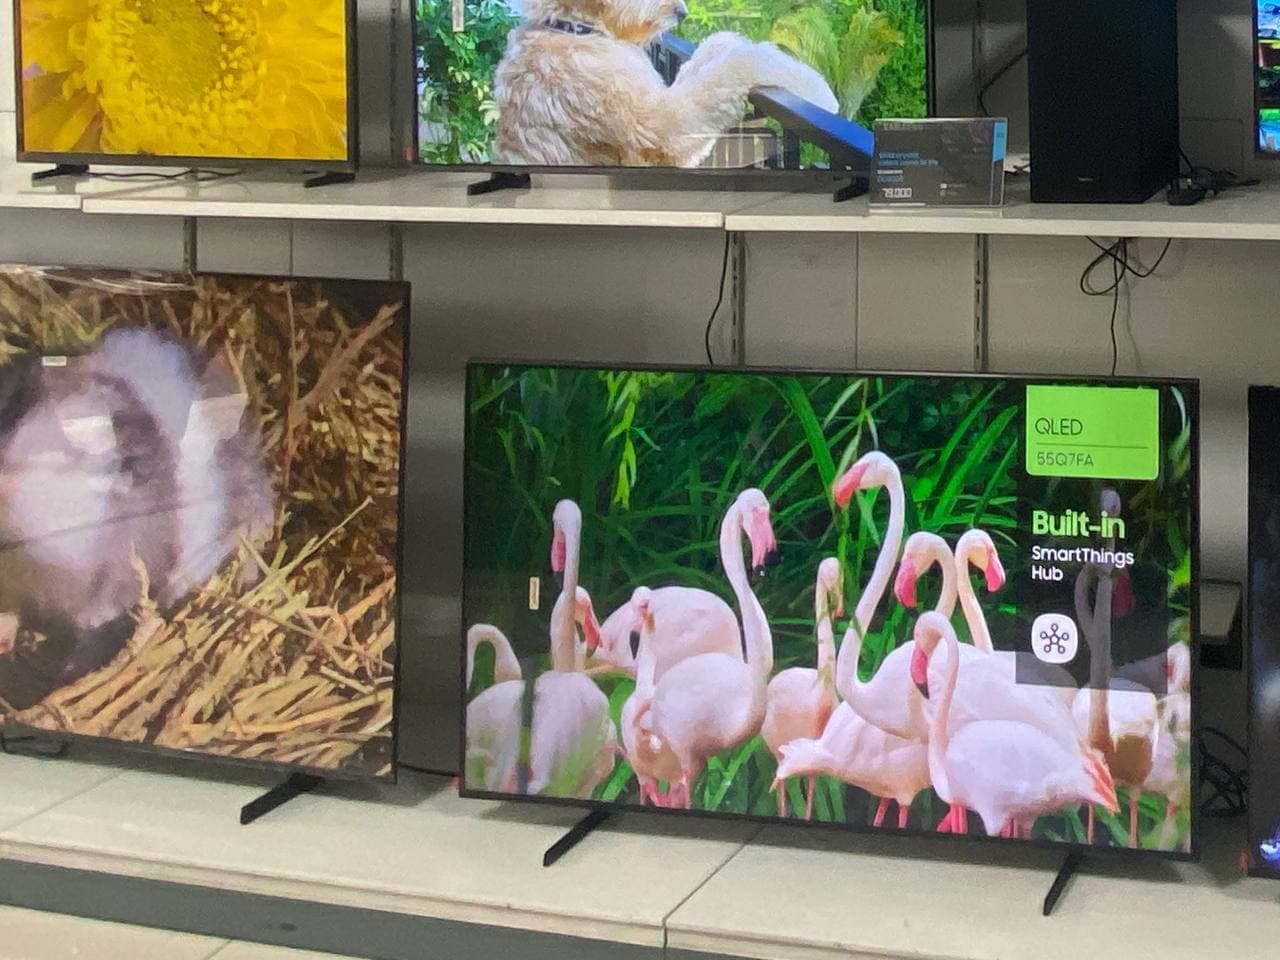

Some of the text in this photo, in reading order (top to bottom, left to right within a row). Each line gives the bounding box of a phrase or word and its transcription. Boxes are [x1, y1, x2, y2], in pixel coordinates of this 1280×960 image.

[1034, 417, 1083, 436] QLED
[1036, 451, 1094, 467] 55Q7FA
[1032, 510, 1126, 539] Built-in
[1032, 545, 1135, 568] SmartThings
[1032, 564, 1064, 582] Hub
